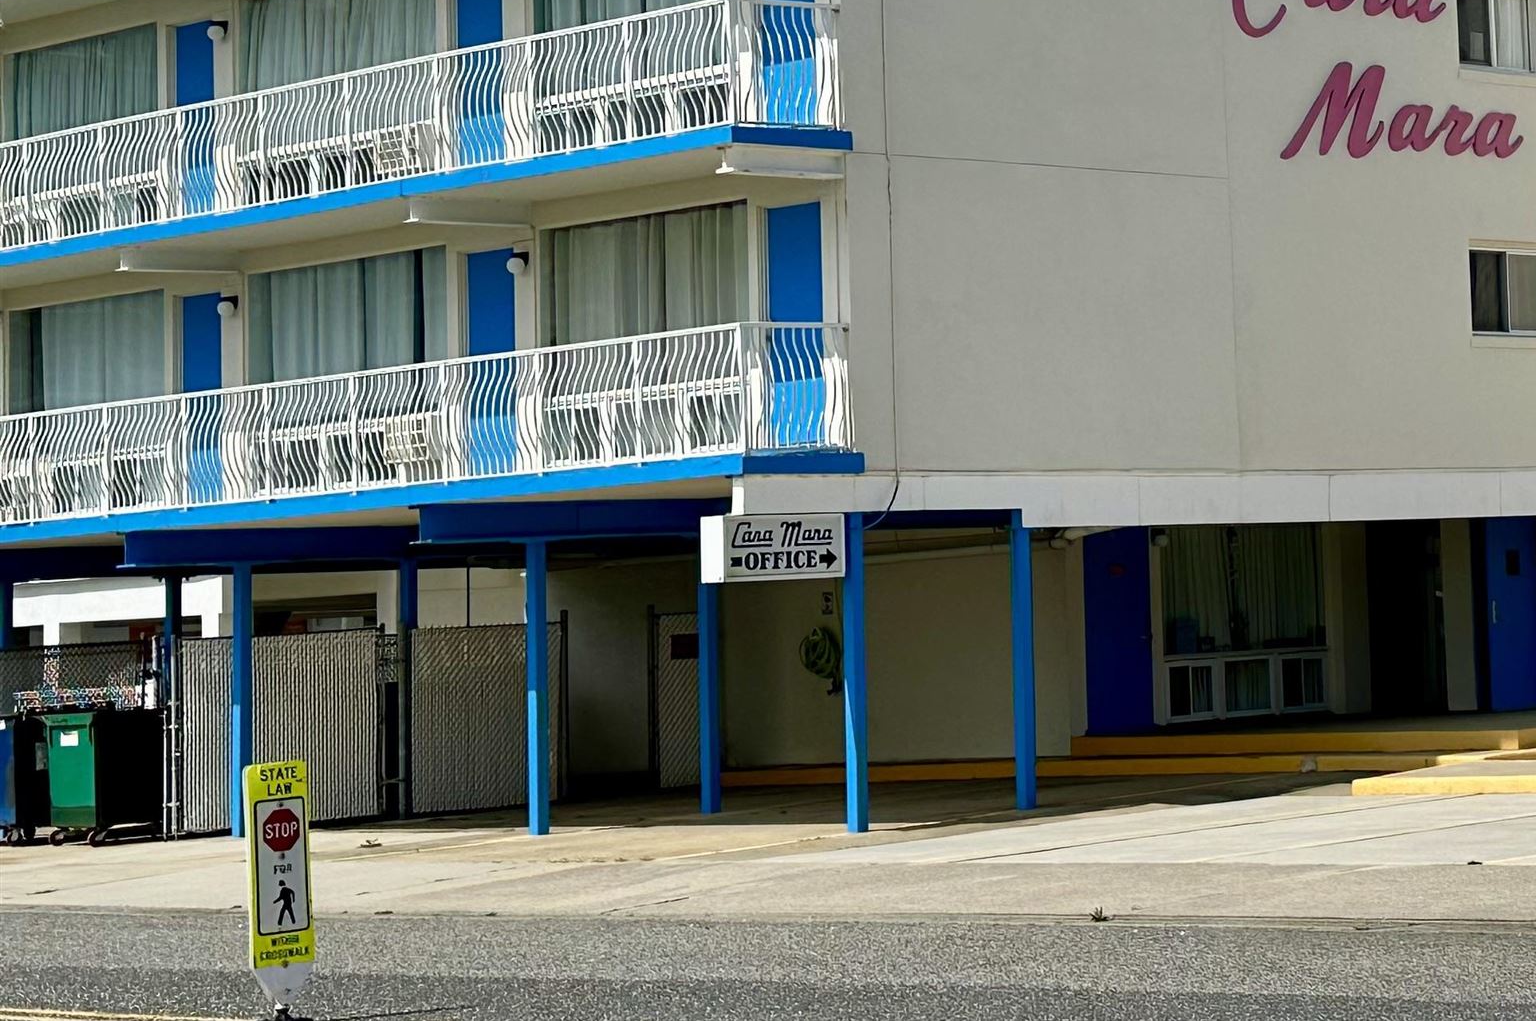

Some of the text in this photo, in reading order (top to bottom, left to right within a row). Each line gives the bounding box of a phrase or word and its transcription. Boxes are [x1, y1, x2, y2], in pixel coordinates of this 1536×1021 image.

[1279, 61, 1524, 160] Mara
[731, 521, 833, 548] Cara Mara
[744, 550, 818, 570] OFFICE
[260, 766, 298, 781] STATE
[267, 782, 292, 796] LAW
[265, 821, 298, 839] STOP
[273, 863, 293, 875] FOR
